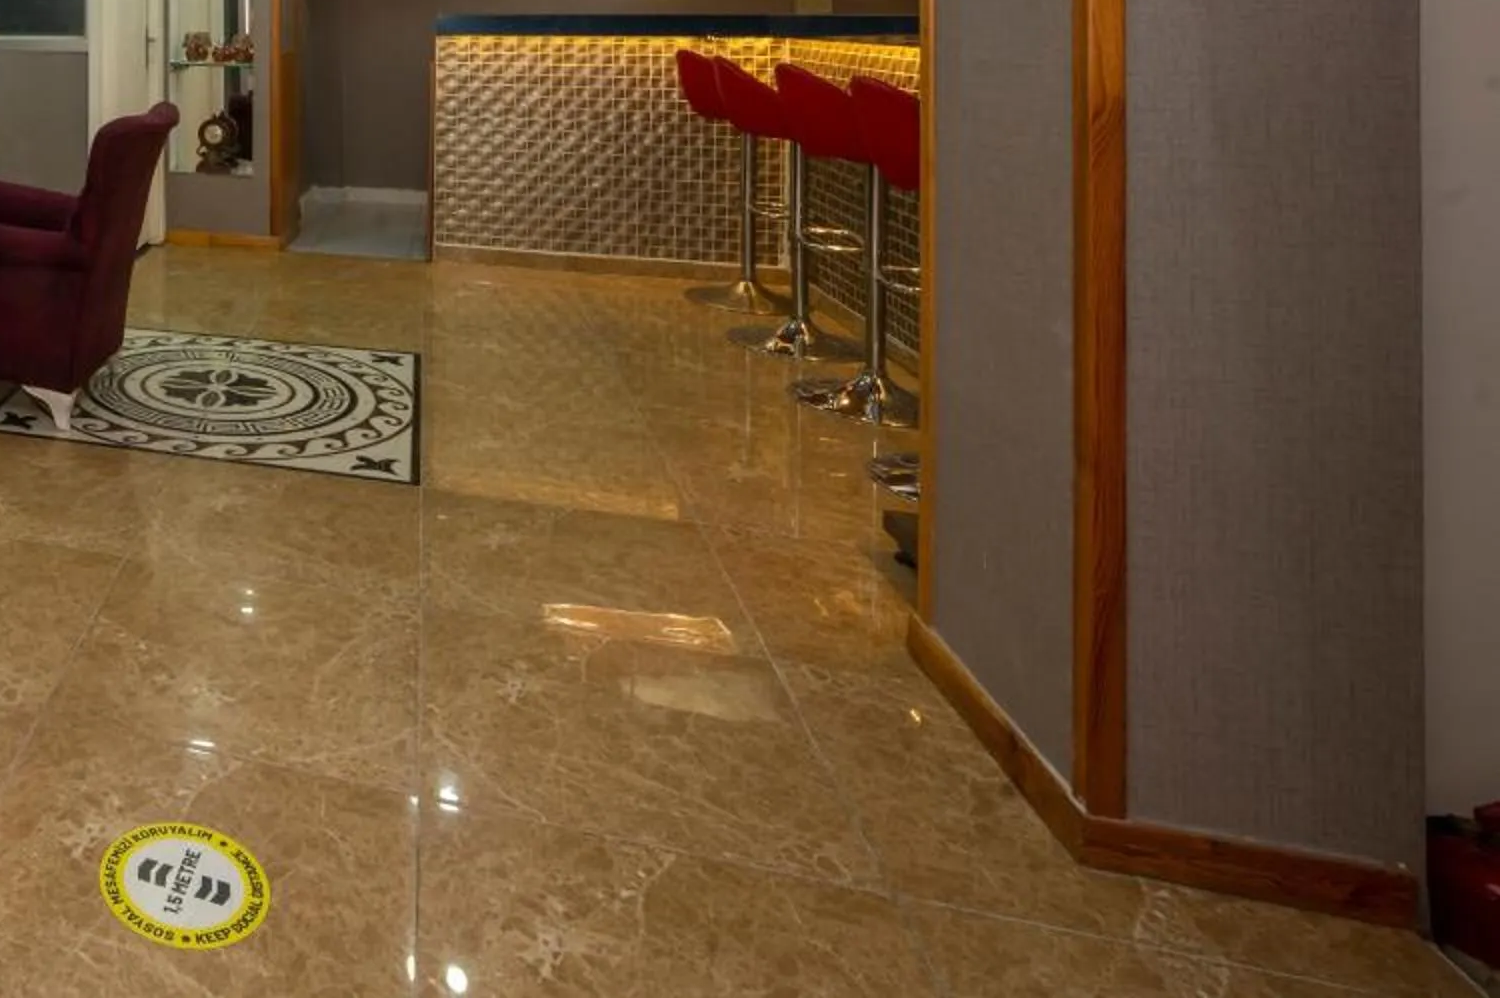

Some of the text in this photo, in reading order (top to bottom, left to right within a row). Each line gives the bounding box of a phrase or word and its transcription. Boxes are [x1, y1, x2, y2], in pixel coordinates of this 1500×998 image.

[131, 825, 213, 843] KORUYALIM
[171, 848, 202, 895] METRE
[121, 906, 175, 941] SOSYAL
[195, 928, 231, 945] KEEP
[230, 900, 263, 934] SOCIAL
